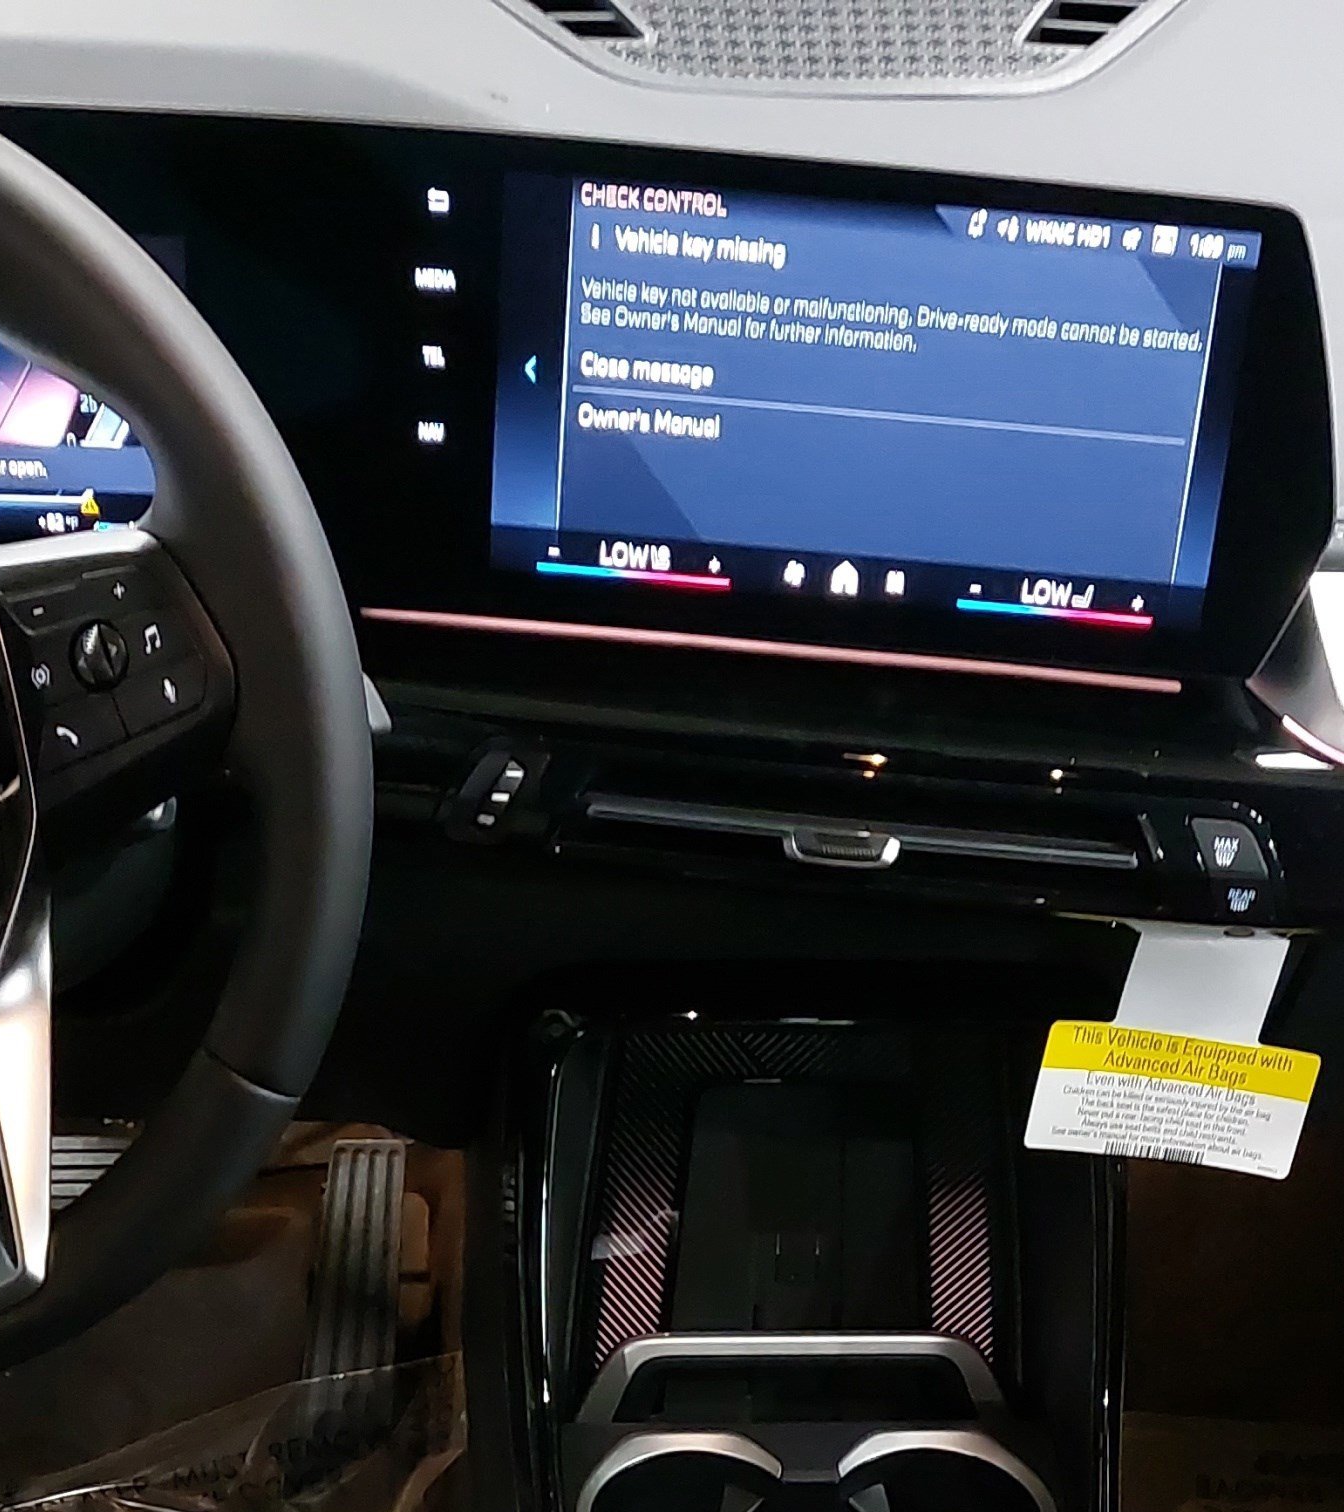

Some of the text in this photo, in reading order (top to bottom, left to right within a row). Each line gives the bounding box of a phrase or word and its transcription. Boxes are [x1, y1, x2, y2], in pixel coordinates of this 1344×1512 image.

[581, 182, 727, 218] CHECK CONTROL
[614, 225, 788, 270] Vehicle key missing
[580, 303, 611, 327] See
[614, 305, 680, 333] Owner's
[683, 310, 743, 339] Manual
[745, 316, 767, 340] for
[769, 320, 823, 345] further
[581, 276, 637, 304] Vehicle
[641, 280, 669, 309] key
[672, 286, 698, 307] not
[701, 289, 770, 316] available
[773, 297, 791, 316] or
[917, 304, 1010, 339] Drive-ready
[1012, 315, 1058, 341] mode
[1060, 321, 1117, 346] cannot
[1119, 323, 1139, 348] be
[579, 350, 715, 391] Close message
[417, 420, 445, 444] NAV
[577, 401, 721, 440] Owner's Manual
[598, 540, 649, 569] LOW
[1021, 577, 1072, 608] LOW
[1213, 836, 1240, 851] MAX
[1074, 1025, 1293, 1073] This Vehicle is Equipped with
[1103, 1049, 1248, 1087] Advanced Air Bags
[1086, 1071, 1256, 1108] Even with Advanced Air Bags
